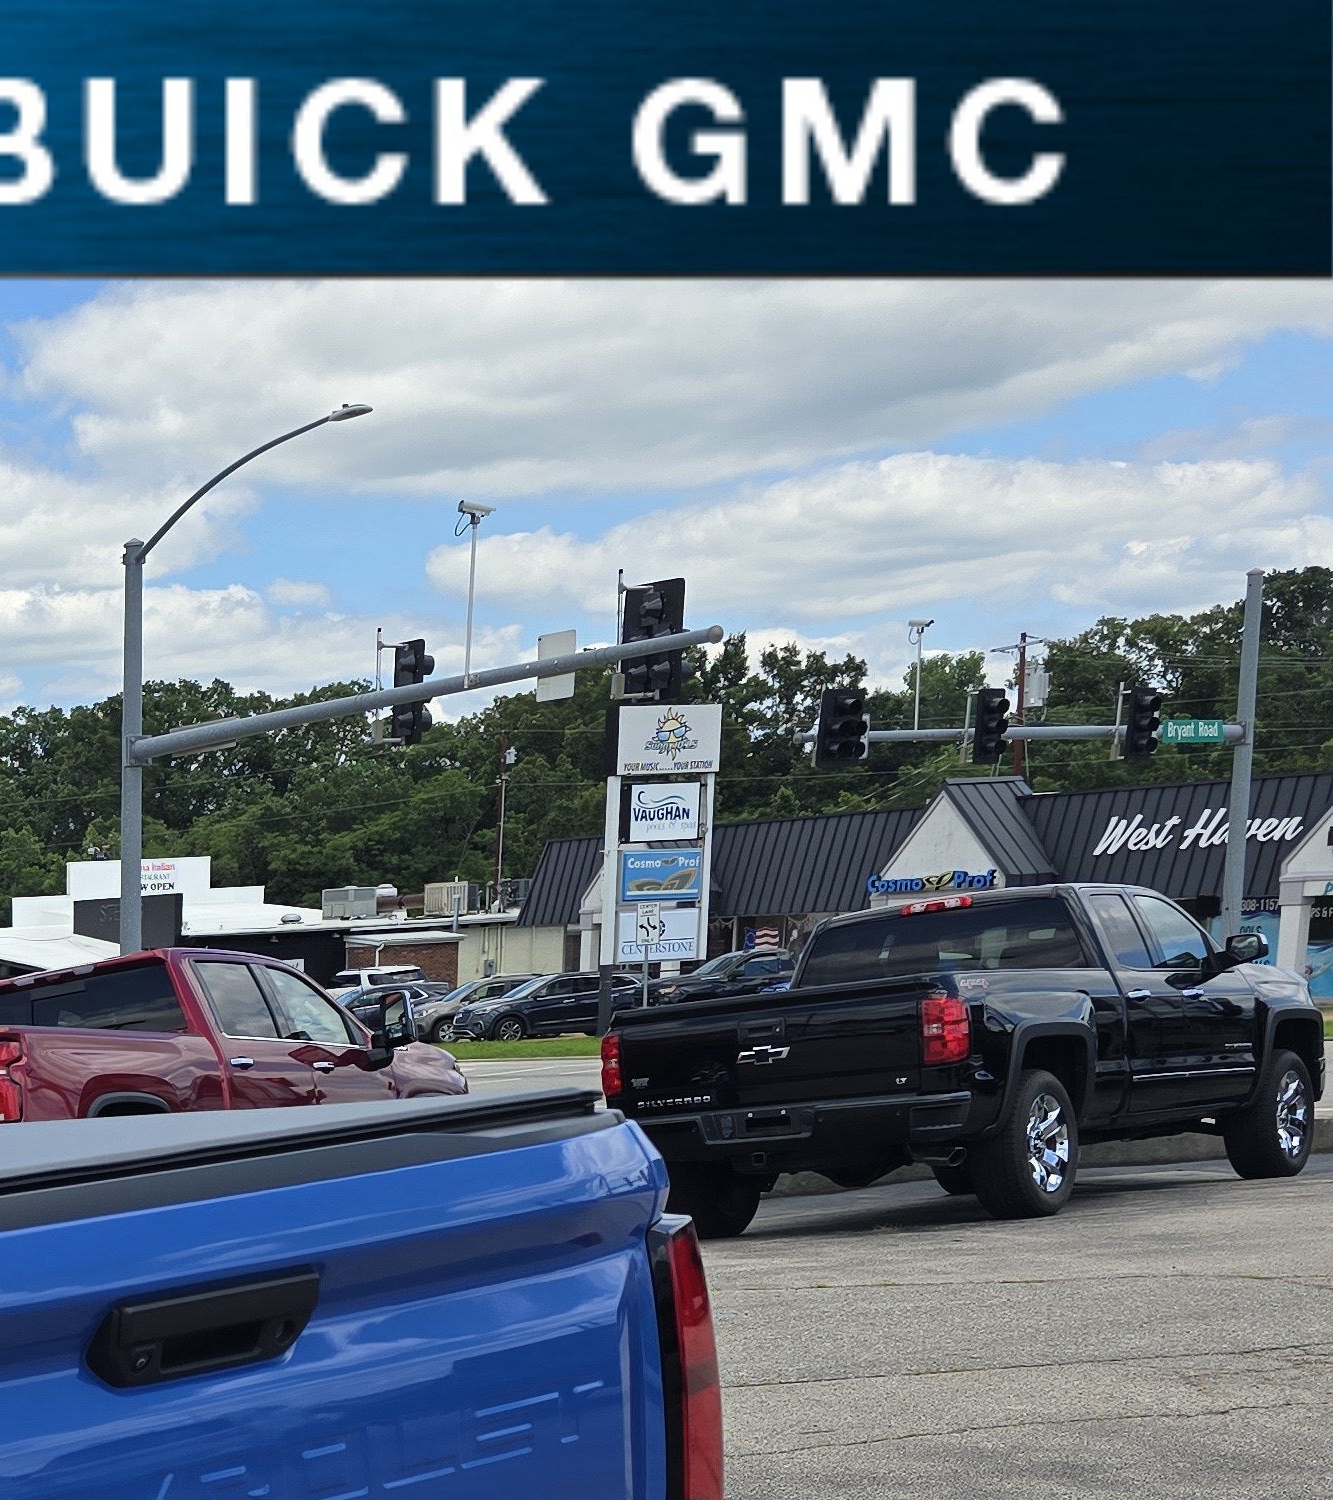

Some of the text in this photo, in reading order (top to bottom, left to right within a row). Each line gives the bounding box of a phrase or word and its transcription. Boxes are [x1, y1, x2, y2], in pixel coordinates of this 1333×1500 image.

[1168, 721, 1218, 741] Bryant Road
[633, 807, 690, 822] VAUGHAN
[1093, 814, 1181, 856] West
[628, 856, 700, 869] Cosmo Prof
[150, 882, 175, 891] OPEN
[868, 868, 997, 893] Cosmo Prof
